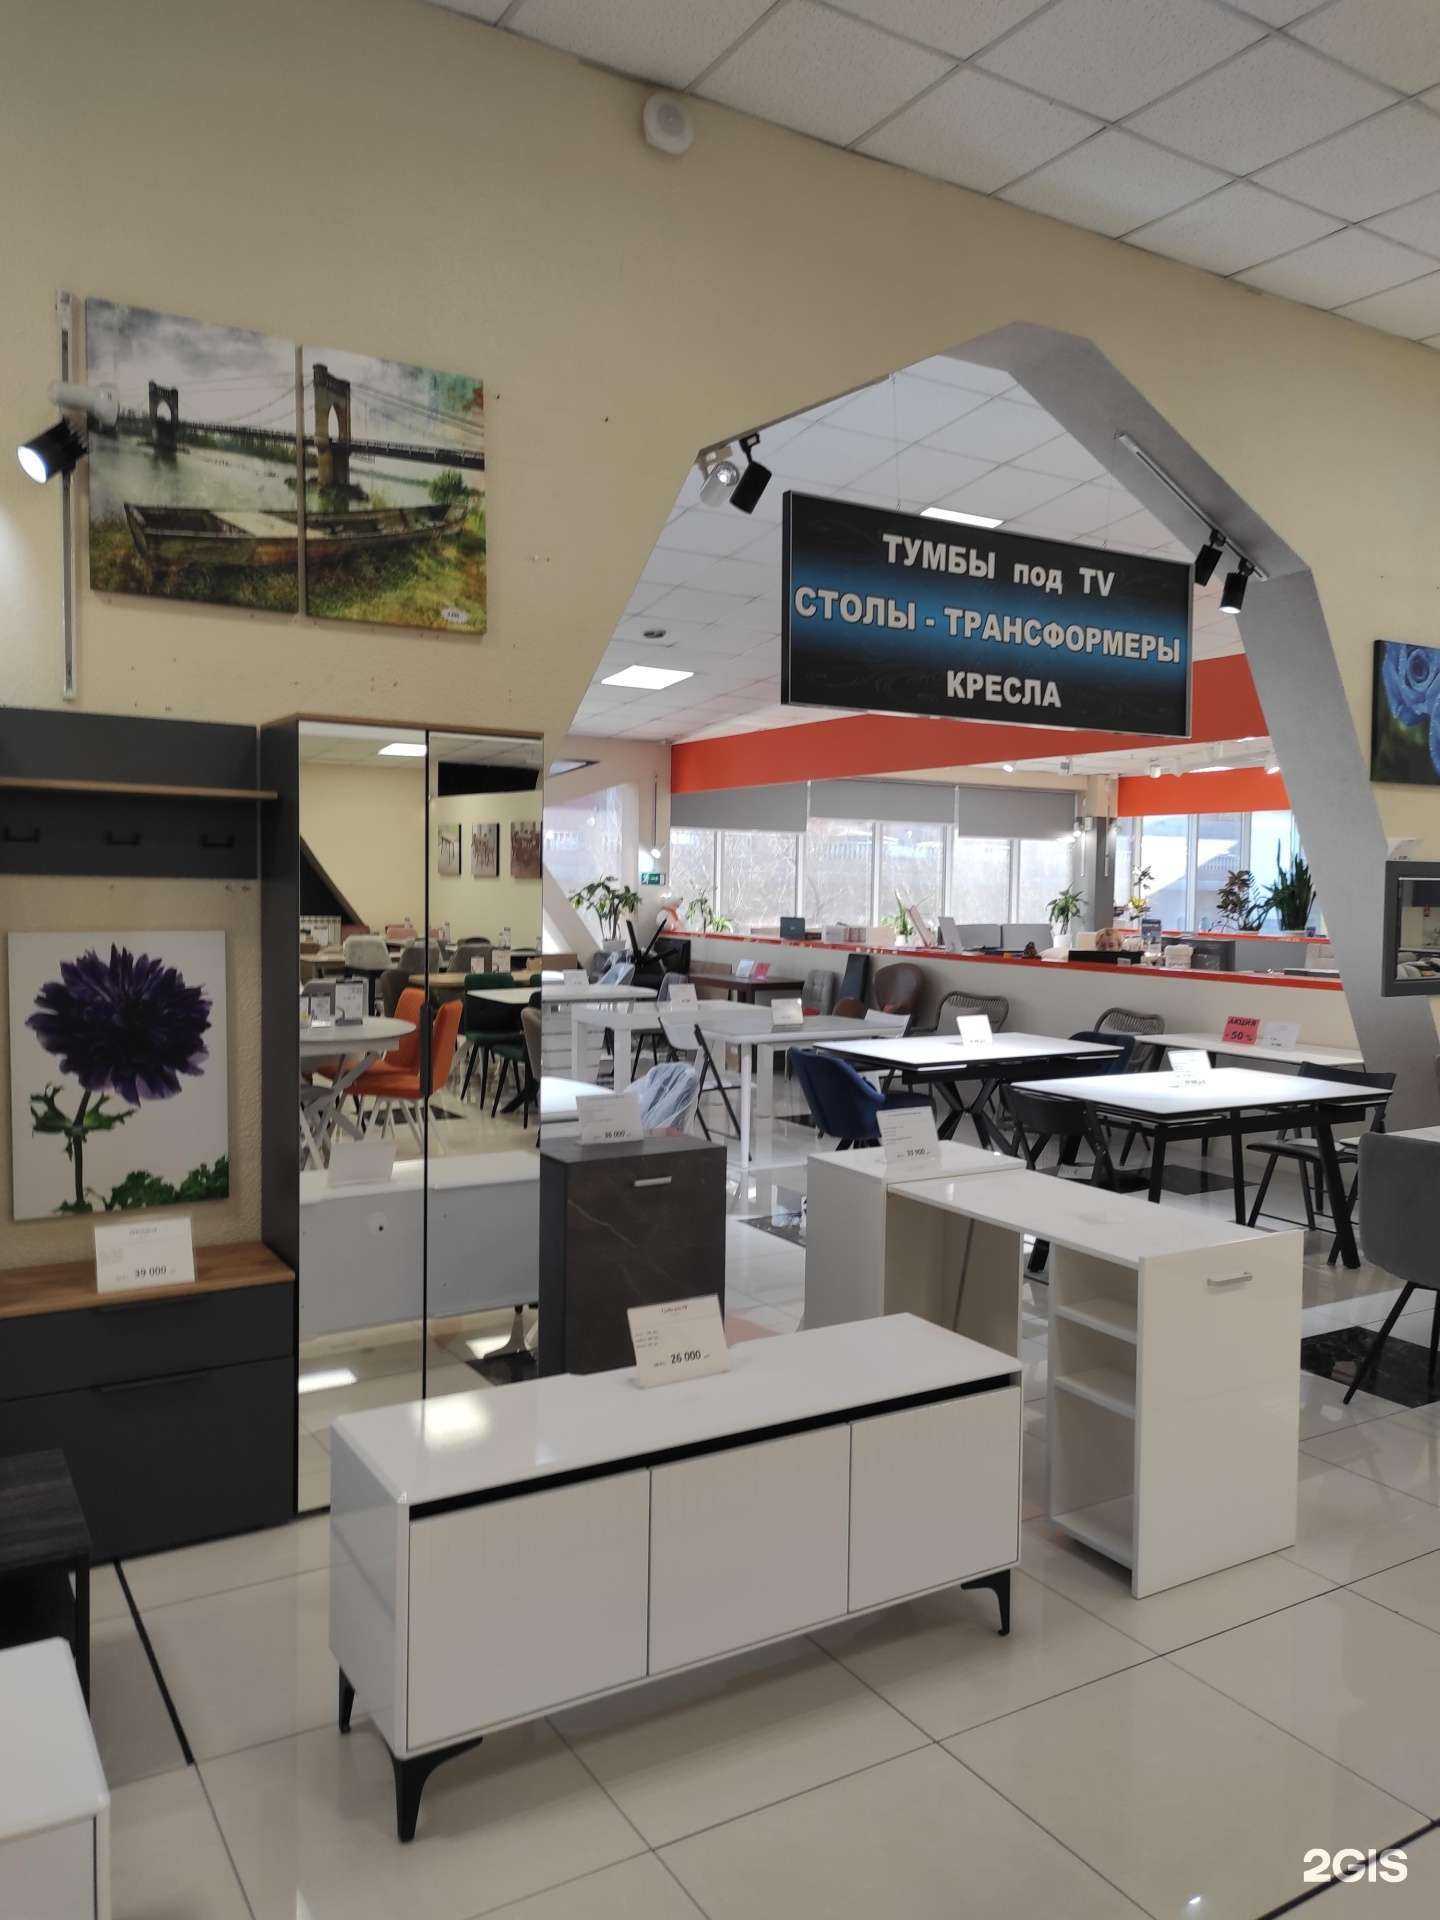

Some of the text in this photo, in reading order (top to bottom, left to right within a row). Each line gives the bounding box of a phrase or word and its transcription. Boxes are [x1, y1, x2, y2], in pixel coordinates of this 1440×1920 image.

[882, 533, 1115, 597] ТУМБЫ под TV
[794, 586, 916, 631] СТОЛЫ
[943, 607, 1181, 664] ТРАНСФОРМЕРЫ
[946, 670, 1062, 709] КРЕСЛА
